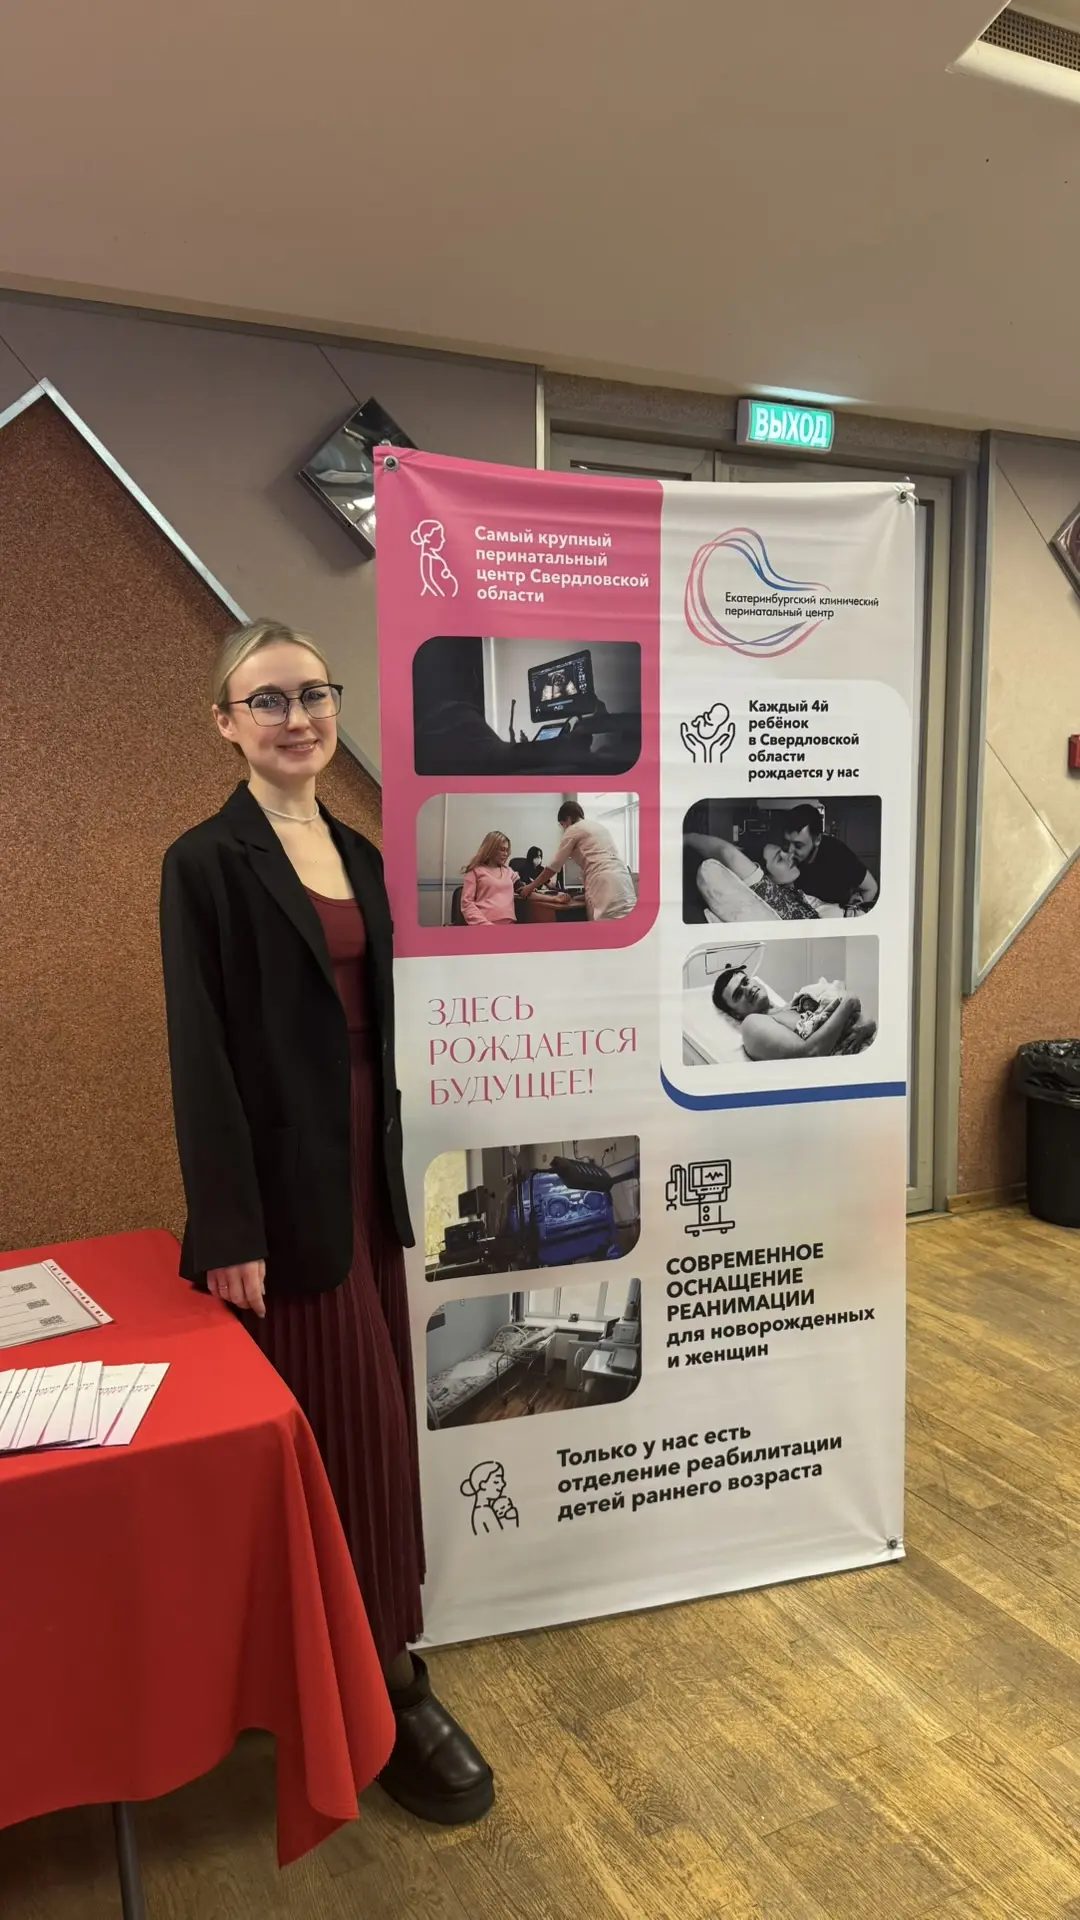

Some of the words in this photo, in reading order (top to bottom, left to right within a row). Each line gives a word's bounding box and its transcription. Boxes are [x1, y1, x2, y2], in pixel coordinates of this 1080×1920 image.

[755, 407, 827, 447] ВЫХОД
[475, 525, 534, 544] Самый
[538, 532, 612, 553] крупный
[476, 549, 608, 566] перинатальный
[476, 568, 526, 585] центр
[530, 568, 649, 588] Свердловской
[477, 585, 545, 602] области
[725, 592, 816, 606] Екатеринбургский
[819, 596, 879, 607] клинический
[725, 607, 802, 618] перинатальный
[805, 609, 834, 620] центр
[749, 700, 808, 714] Каждый
[811, 700, 829, 712] 4й
[749, 716, 809, 732] ребёнок
[749, 736, 757, 746] в
[760, 733, 859, 748] Свердловской
[748, 749, 805, 762] области
[749, 768, 823, 782] рождается
[826, 768, 834, 781] у
[837, 767, 859, 778] нас
[428, 995, 534, 1028] ЗДЕСЬ
[430, 1027, 637, 1065] РОЖДАЕТСЯ
[430, 1068, 593, 1107] БУДУЩЕЕ!
[666, 1243, 824, 1275] СОВРЕМЕННОЕ
[666, 1267, 804, 1298] ОСНАЩЕНИЕ
[667, 1289, 815, 1322] РЕАНИМАЦИИ
[666, 1328, 705, 1347] для
[711, 1308, 875, 1338] новорожденных
[668, 1356, 680, 1368] и
[685, 1344, 769, 1366] женщин
[556, 1443, 637, 1467] Только
[643, 1440, 656, 1459] у
[662, 1433, 698, 1451] нас
[704, 1426, 751, 1445] есть
[557, 1461, 681, 1493] отделение
[687, 1436, 842, 1477] реабилитации
[557, 1492, 625, 1522] детей
[632, 1478, 722, 1511] раннего
[728, 1463, 823, 1489] возраста
